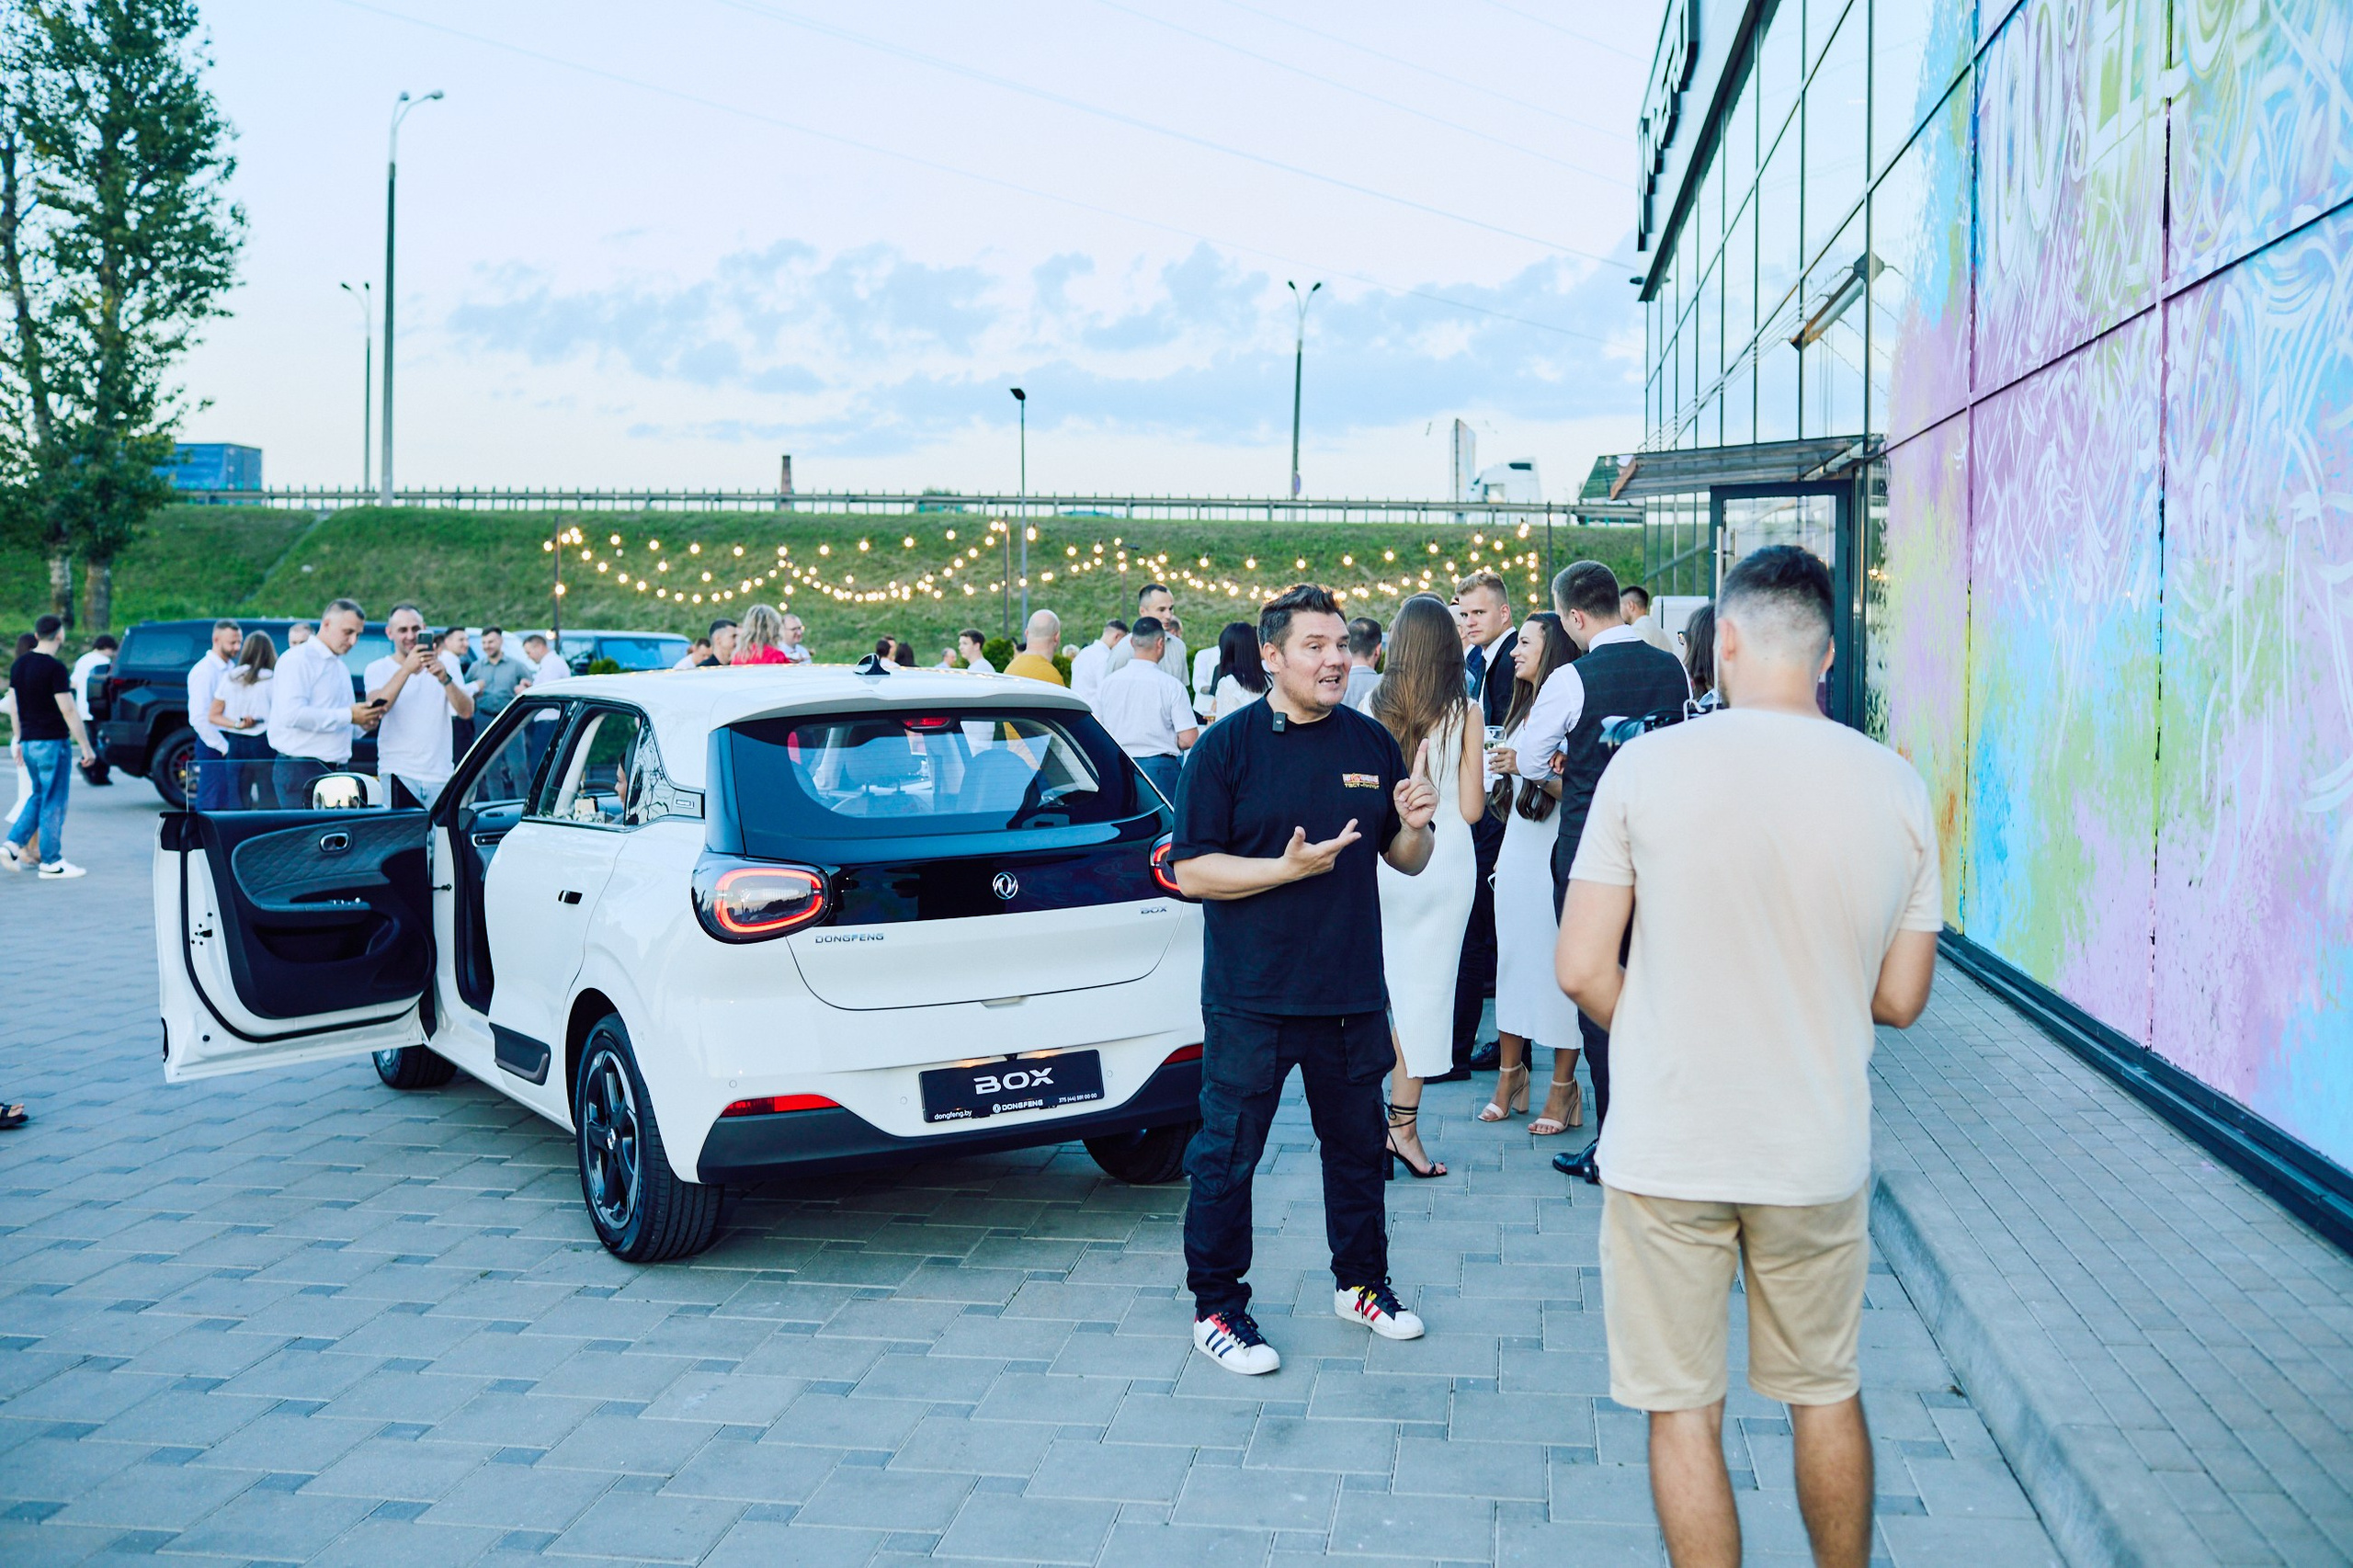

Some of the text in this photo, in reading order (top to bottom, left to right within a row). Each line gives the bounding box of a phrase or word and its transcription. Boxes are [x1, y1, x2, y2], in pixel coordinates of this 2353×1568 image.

[1140, 905, 1167, 915] BOX
[815, 933, 884, 944] DONGFENG
[973, 1067, 1054, 1095] BOX
[1001, 1098, 1043, 1111] DONGFENG
[934, 1109, 972, 1120] dongfeng.by
